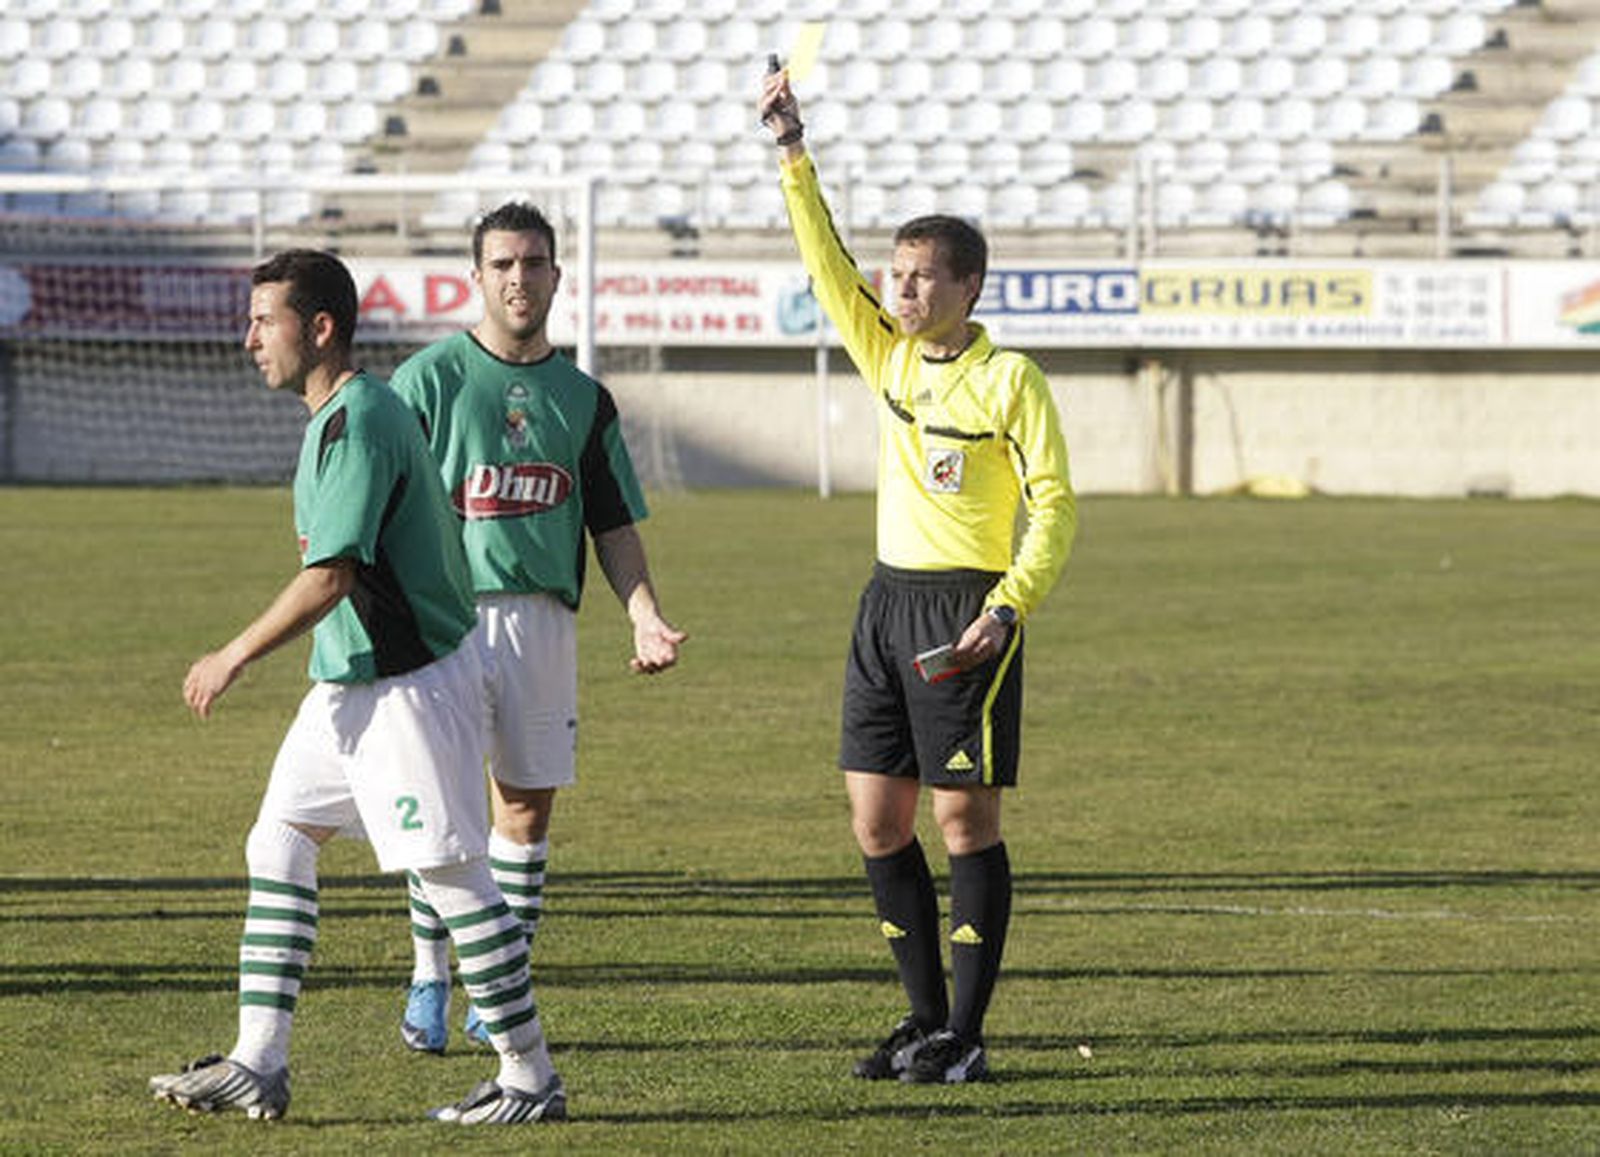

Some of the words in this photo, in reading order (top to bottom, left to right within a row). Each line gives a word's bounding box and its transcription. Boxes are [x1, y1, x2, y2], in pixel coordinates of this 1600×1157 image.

[1145, 275, 1363, 309] GRUAS
[470, 463, 560, 505] Dhul
[396, 796, 424, 831] 2
